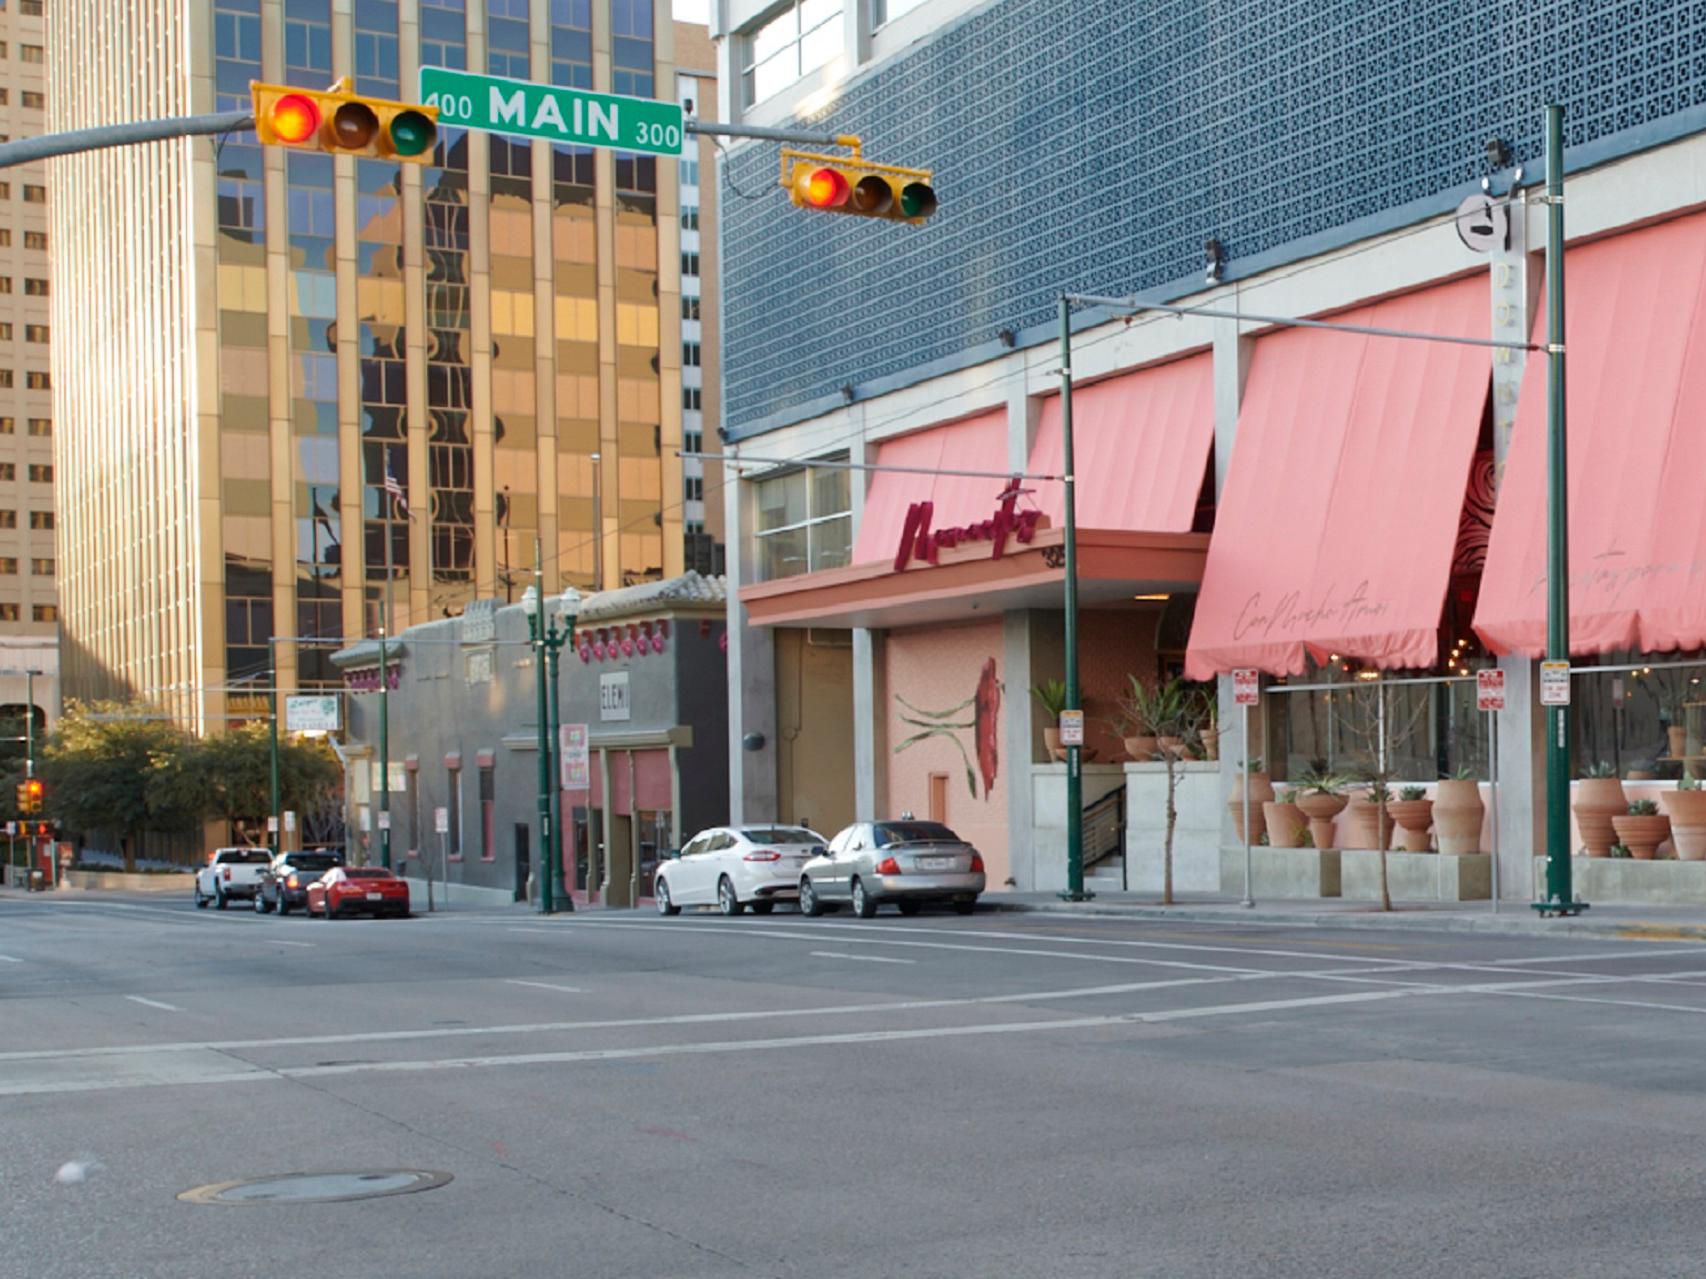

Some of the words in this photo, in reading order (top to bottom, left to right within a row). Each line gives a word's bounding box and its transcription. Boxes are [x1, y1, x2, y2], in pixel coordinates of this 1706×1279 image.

[424, 91, 473, 120] 400
[489, 85, 619, 141] MAIN
[635, 121, 680, 148] 300
